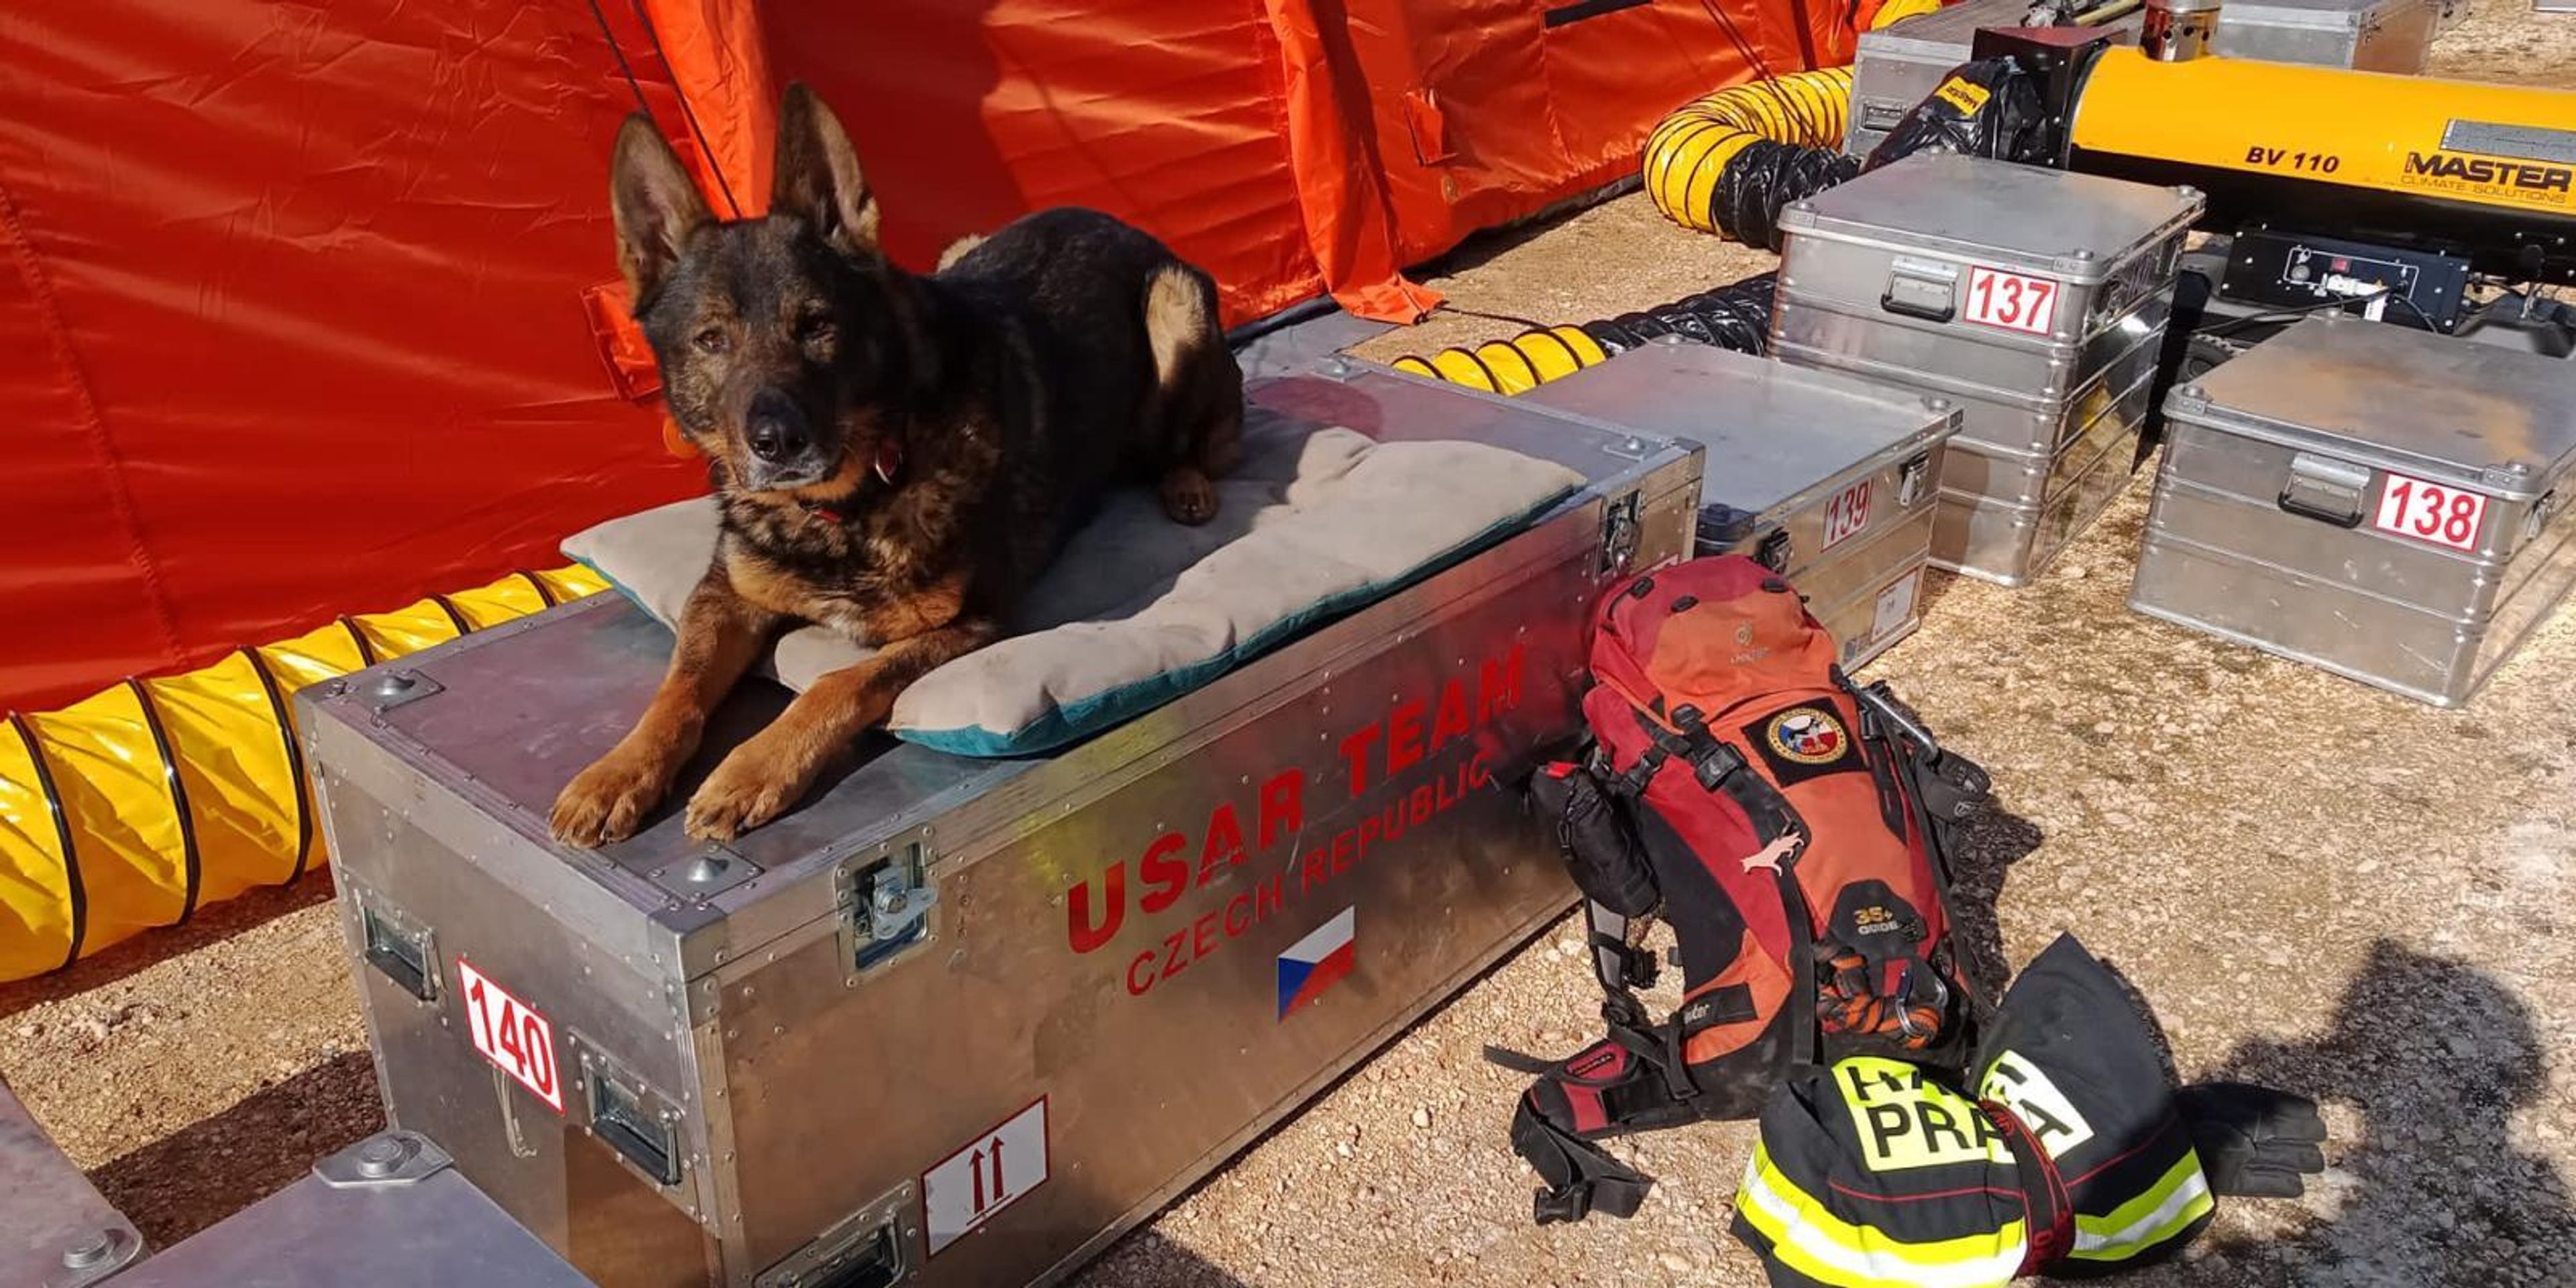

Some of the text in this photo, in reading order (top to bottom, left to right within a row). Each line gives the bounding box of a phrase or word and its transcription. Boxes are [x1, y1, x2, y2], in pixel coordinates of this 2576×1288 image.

[2245, 146, 2339, 173] BV 110
[2401, 176, 2565, 204] CLIMATE SOLUTIONS
[2404, 152, 2572, 192] MASTER
[1977, 274, 2051, 327] 137
[1829, 481, 1868, 542] 139
[2390, 481, 2476, 543] 138
[1068, 644, 1524, 954] USAR TEAM
[1127, 748, 1492, 996] CZECH REPUBLIC
[471, 977, 552, 1095] 140
